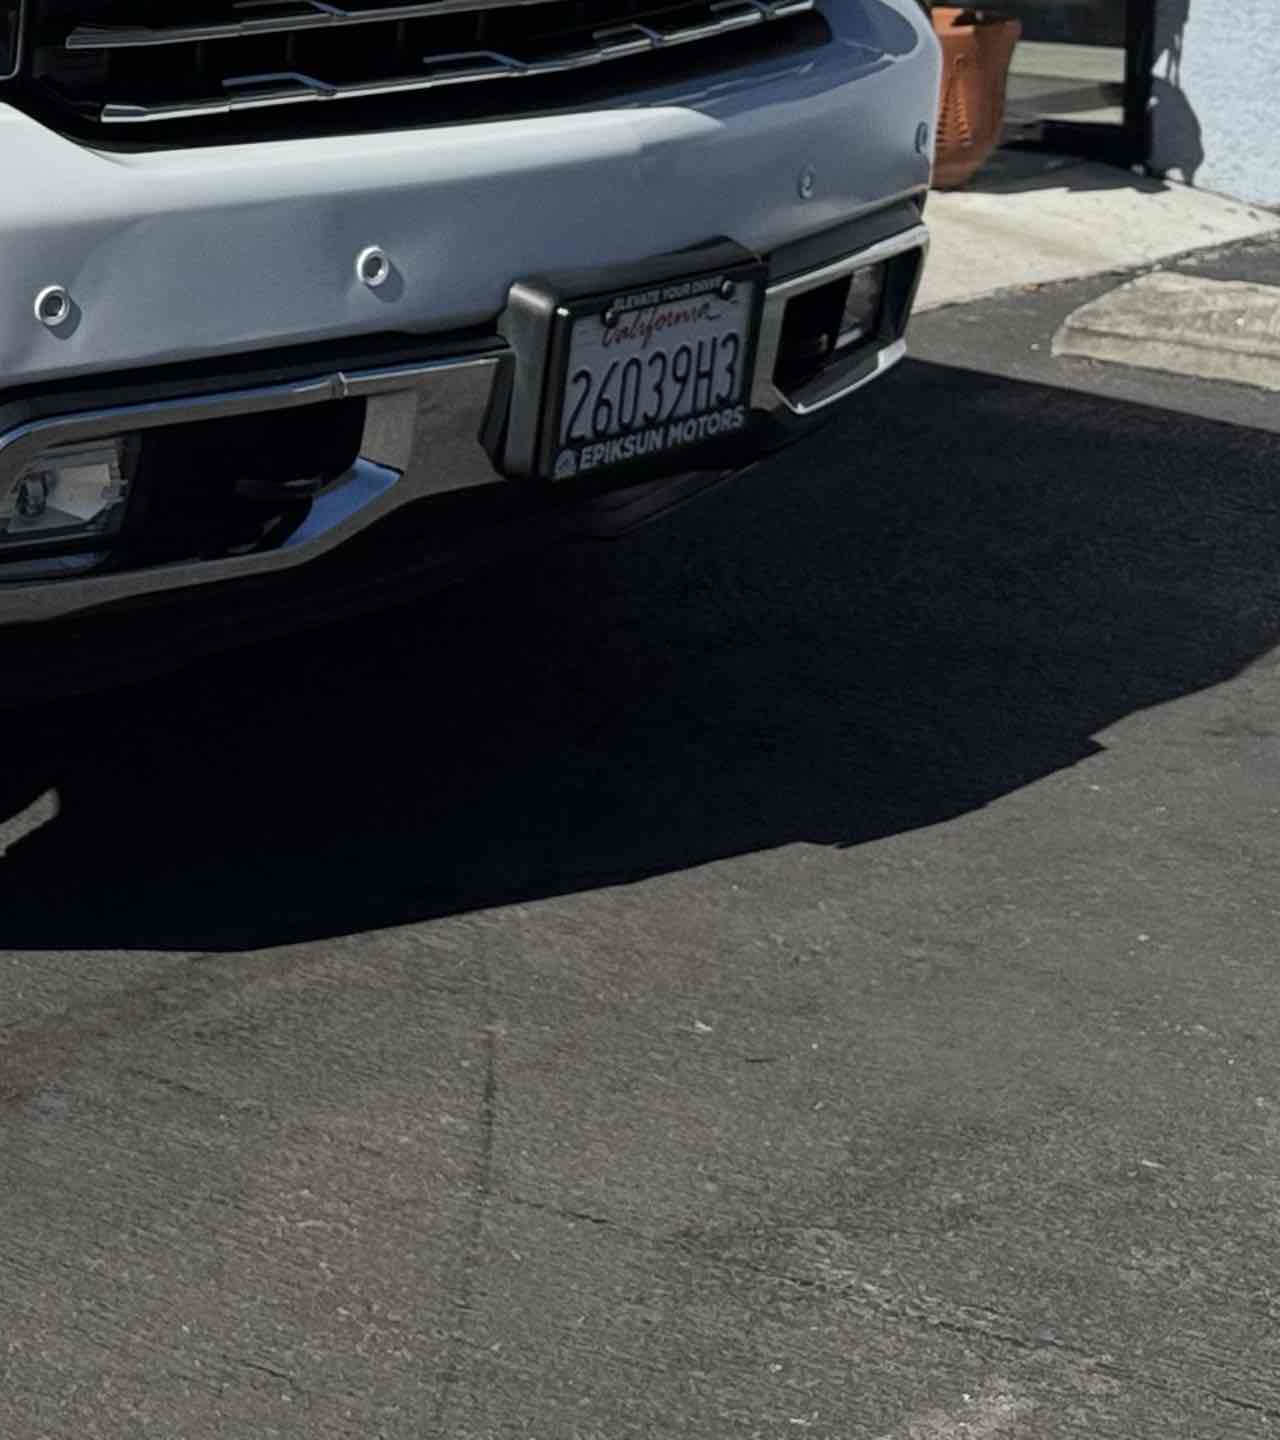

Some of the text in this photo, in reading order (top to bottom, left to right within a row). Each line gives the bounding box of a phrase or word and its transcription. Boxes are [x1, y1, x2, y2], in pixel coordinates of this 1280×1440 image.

[602, 303, 721, 350] California
[565, 332, 739, 443] 26039H3
[580, 406, 745, 471] EPIKSUN MOTORS
